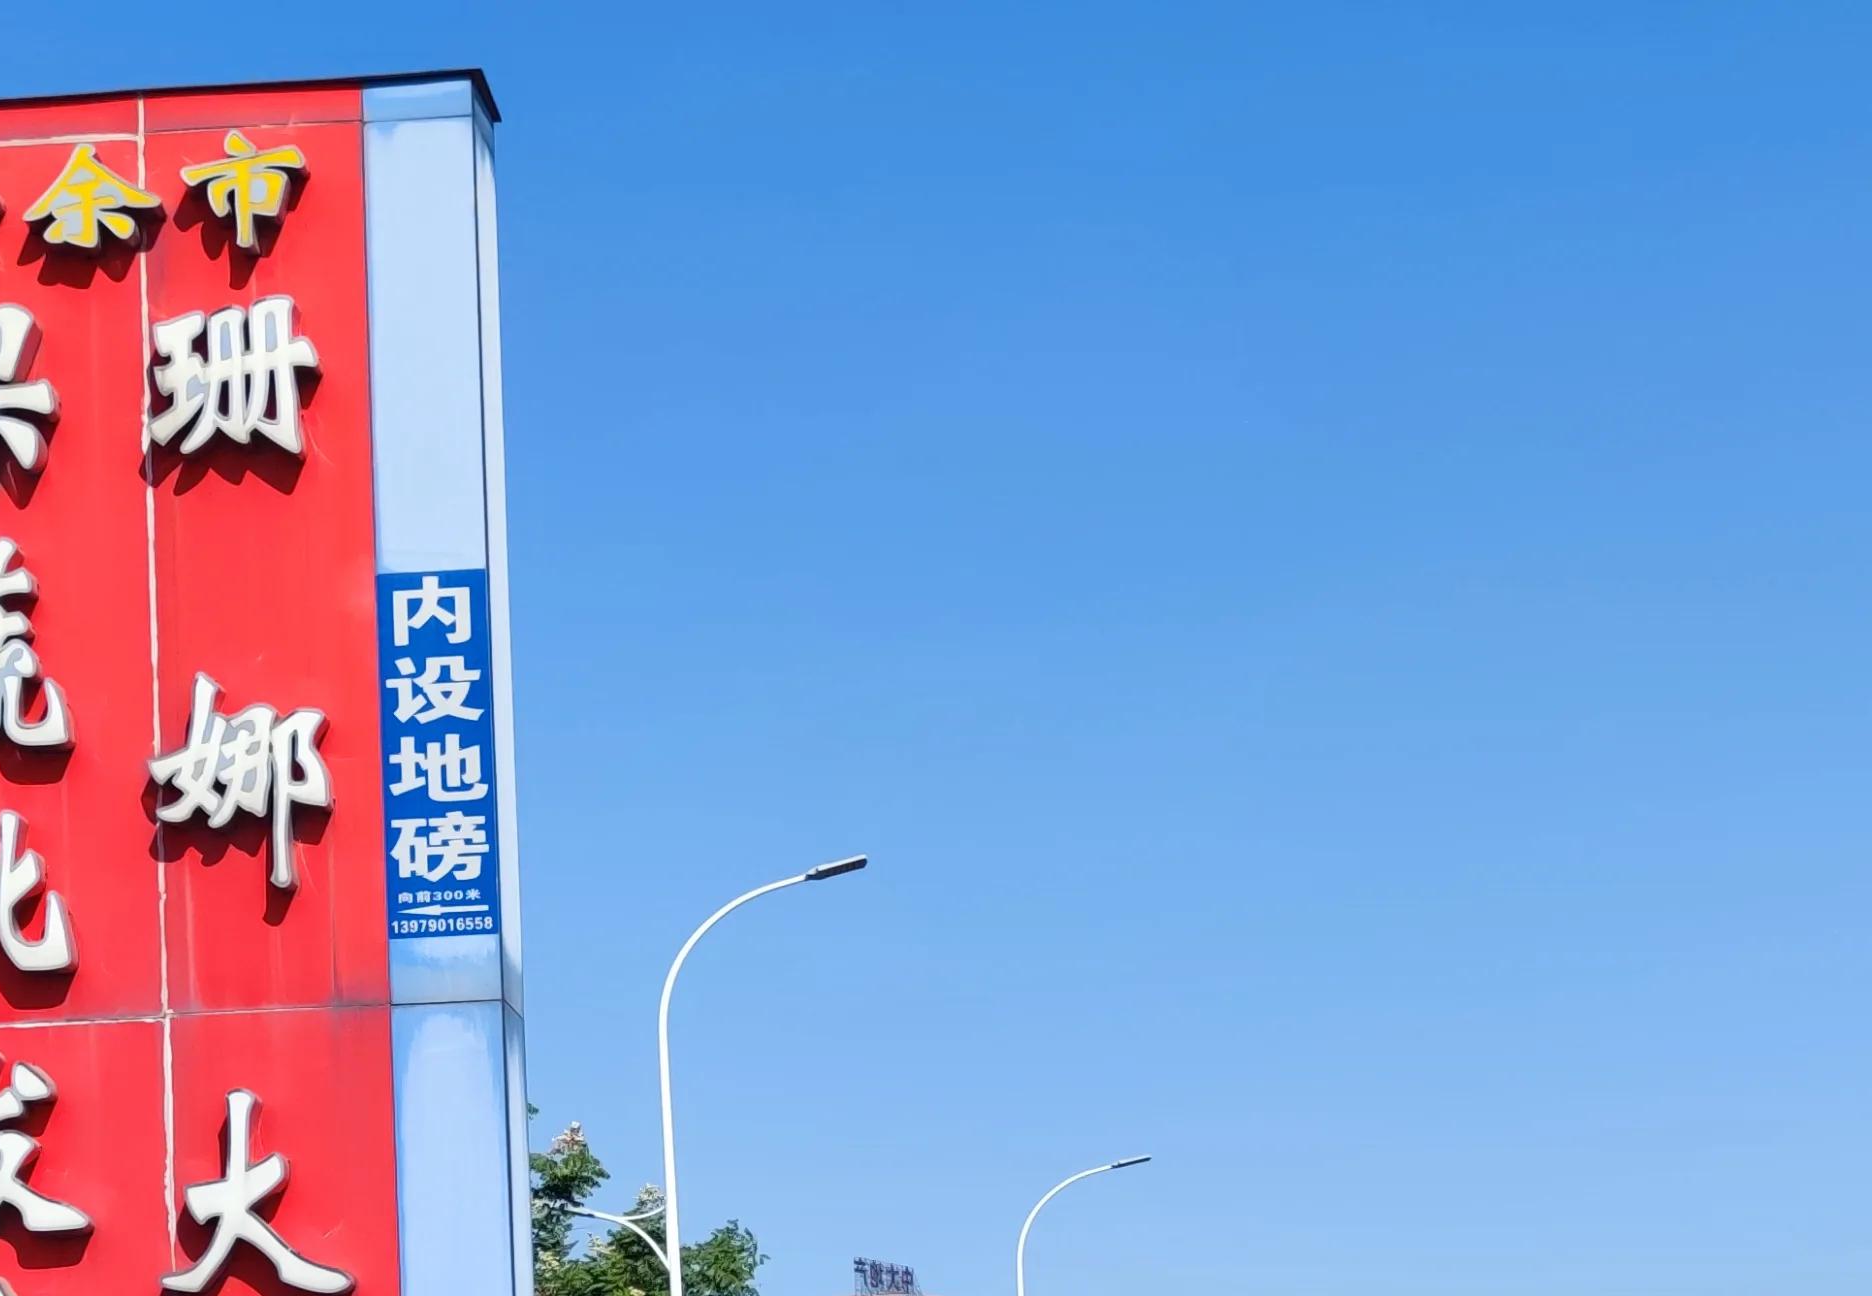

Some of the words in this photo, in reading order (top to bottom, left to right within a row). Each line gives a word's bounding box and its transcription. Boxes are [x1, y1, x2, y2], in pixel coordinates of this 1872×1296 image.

[386, 576, 489, 882] 内设地磅
[398, 888, 481, 904] 向前300米
[391, 916, 493, 934] 13979016558
